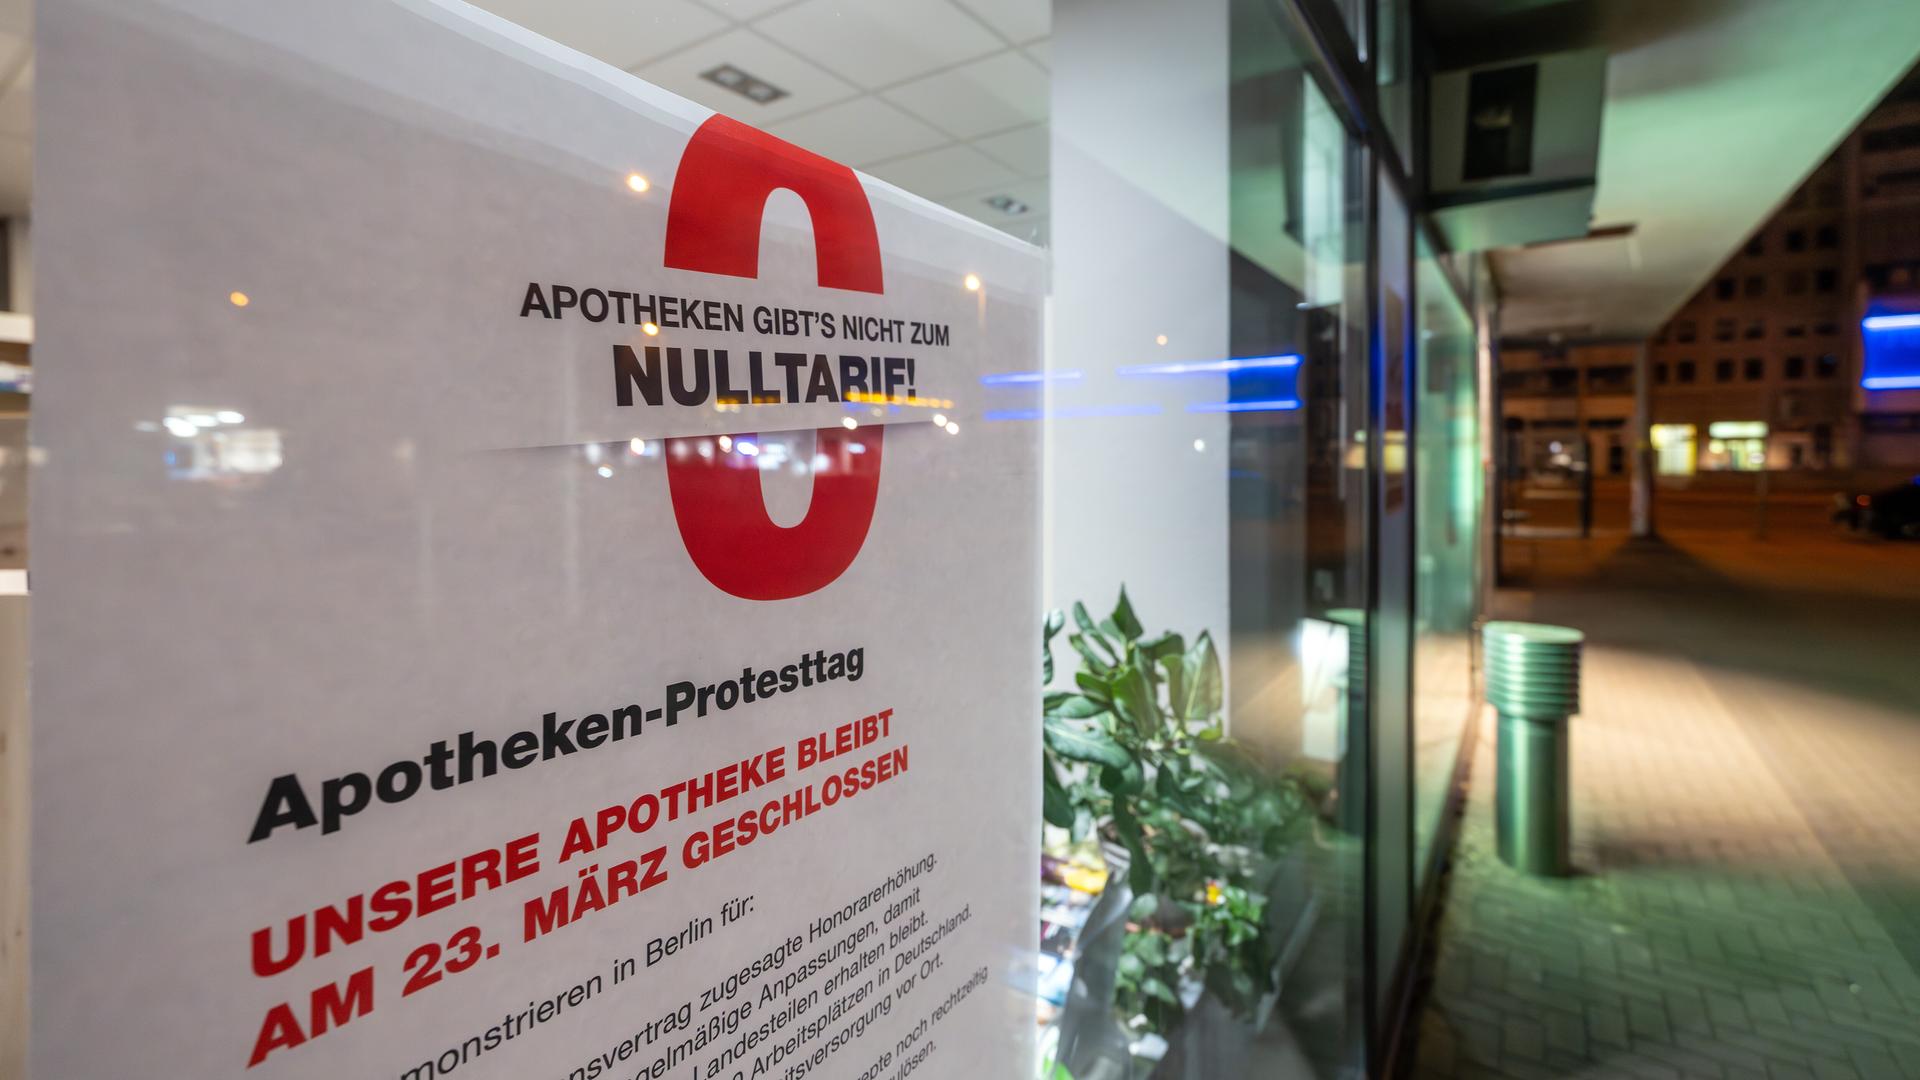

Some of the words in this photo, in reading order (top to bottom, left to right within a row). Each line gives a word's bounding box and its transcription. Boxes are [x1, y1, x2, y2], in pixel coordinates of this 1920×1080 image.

[520, 282, 743, 333] APOTHEKEN
[843, 314, 904, 344] NICHT
[910, 322, 950, 347] ZUM
[613, 344, 916, 407] NULLTARIF!
[247, 646, 864, 844] Apotheken-Protesttag
[250, 833, 540, 978] UNSERE
[559, 747, 785, 863] APOTHEKE
[797, 708, 893, 770] BLEIBT
[247, 966, 374, 1068] AM
[401, 924, 500, 998] 23.
[523, 846, 668, 944] MÄRZ
[682, 745, 909, 870] GESCHLOSSEN
[613, 959, 636, 985] in
[646, 917, 712, 967] Berlin
[720, 895, 754, 926] für:
[700, 936, 803, 1011] zugesagte
[809, 853, 937, 943] Honorarerhöhung.
[758, 921, 878, 1010] Anpassungen,
[883, 887, 920, 925] damit
[824, 943, 885, 995] erhalten
[889, 911, 928, 950] bleibt.
[752, 980, 873, 1080] Arbeitsplätzen
[878, 967, 890, 987] in
[895, 903, 972, 973] Deutschland.
[896, 974, 917, 999] vor
[920, 953, 943, 980] Ort.
[896, 1018, 927, 1058] noch
[931, 966, 988, 1026] rechtzeitig
